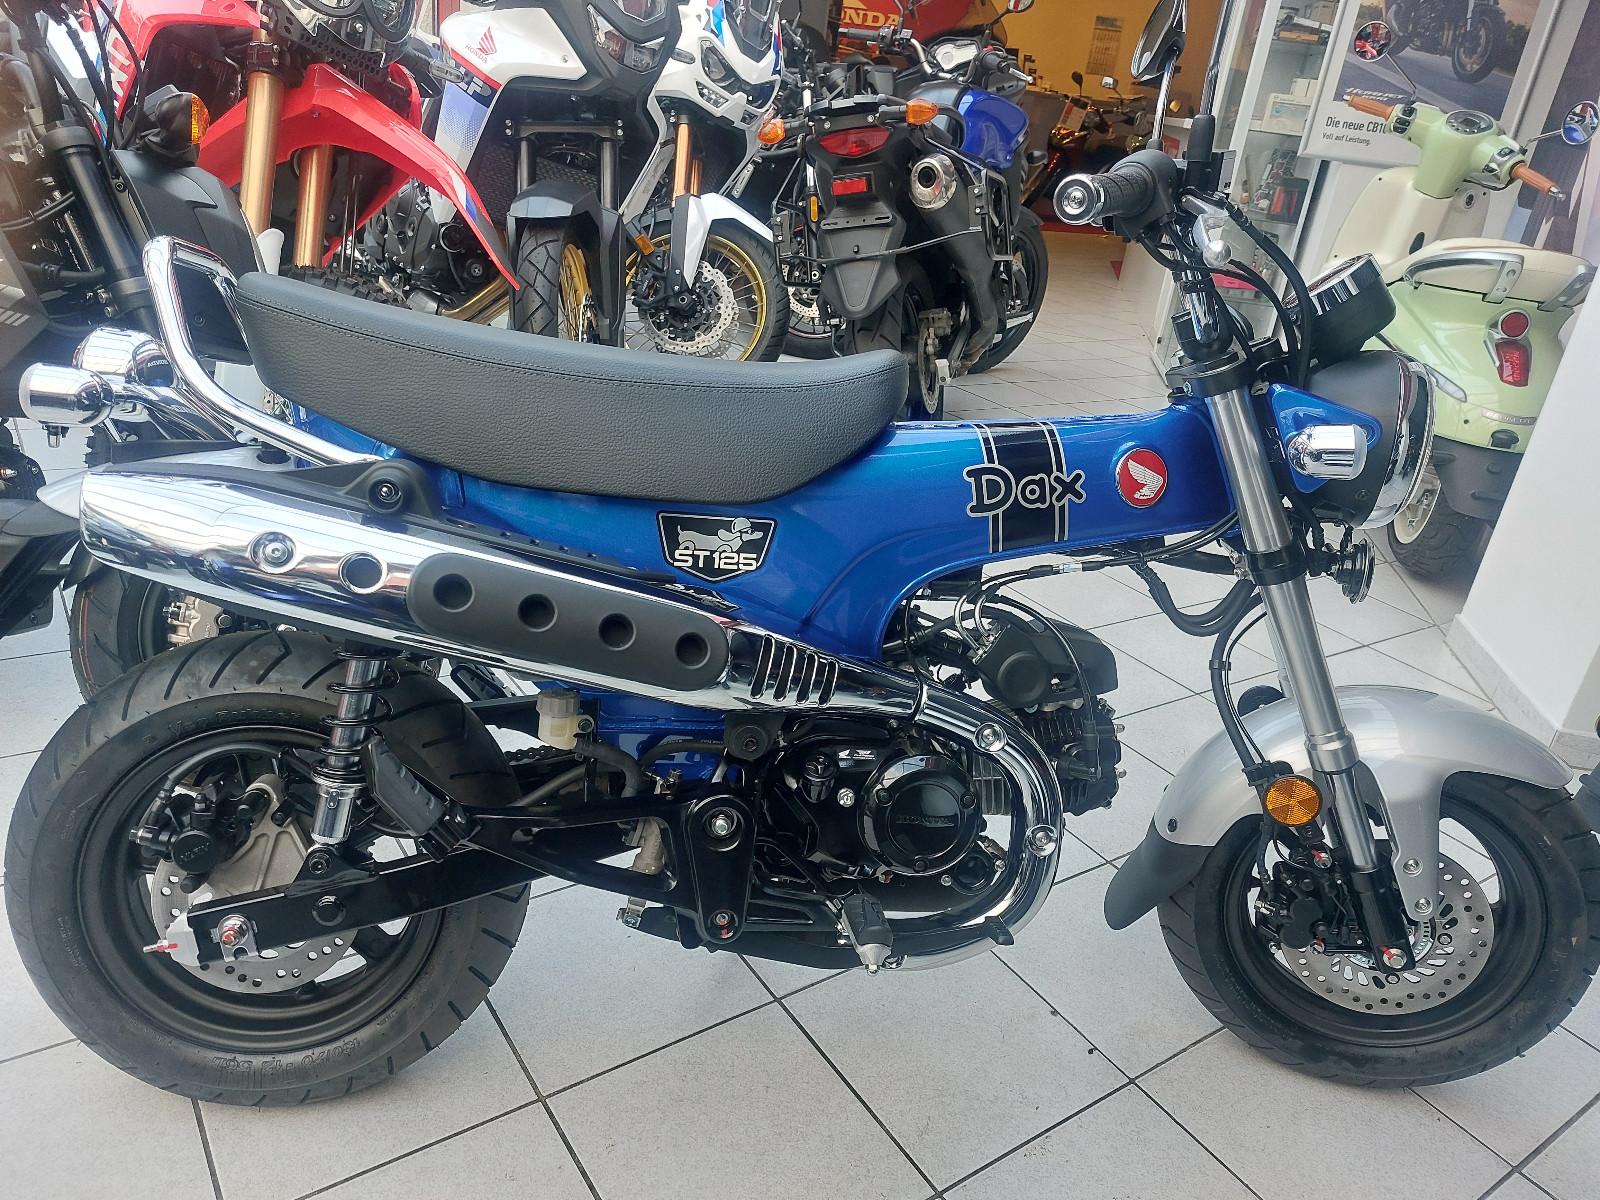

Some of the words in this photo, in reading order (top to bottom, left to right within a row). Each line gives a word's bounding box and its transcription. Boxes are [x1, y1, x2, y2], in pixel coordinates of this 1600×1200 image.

[464, 43, 489, 64] HONDA
[1325, 116, 1341, 128] Die
[1342, 120, 1365, 131] neue
[1322, 132, 1334, 141] Voll
[1334, 134, 1346, 142] auf
[962, 463, 1087, 518] Dax
